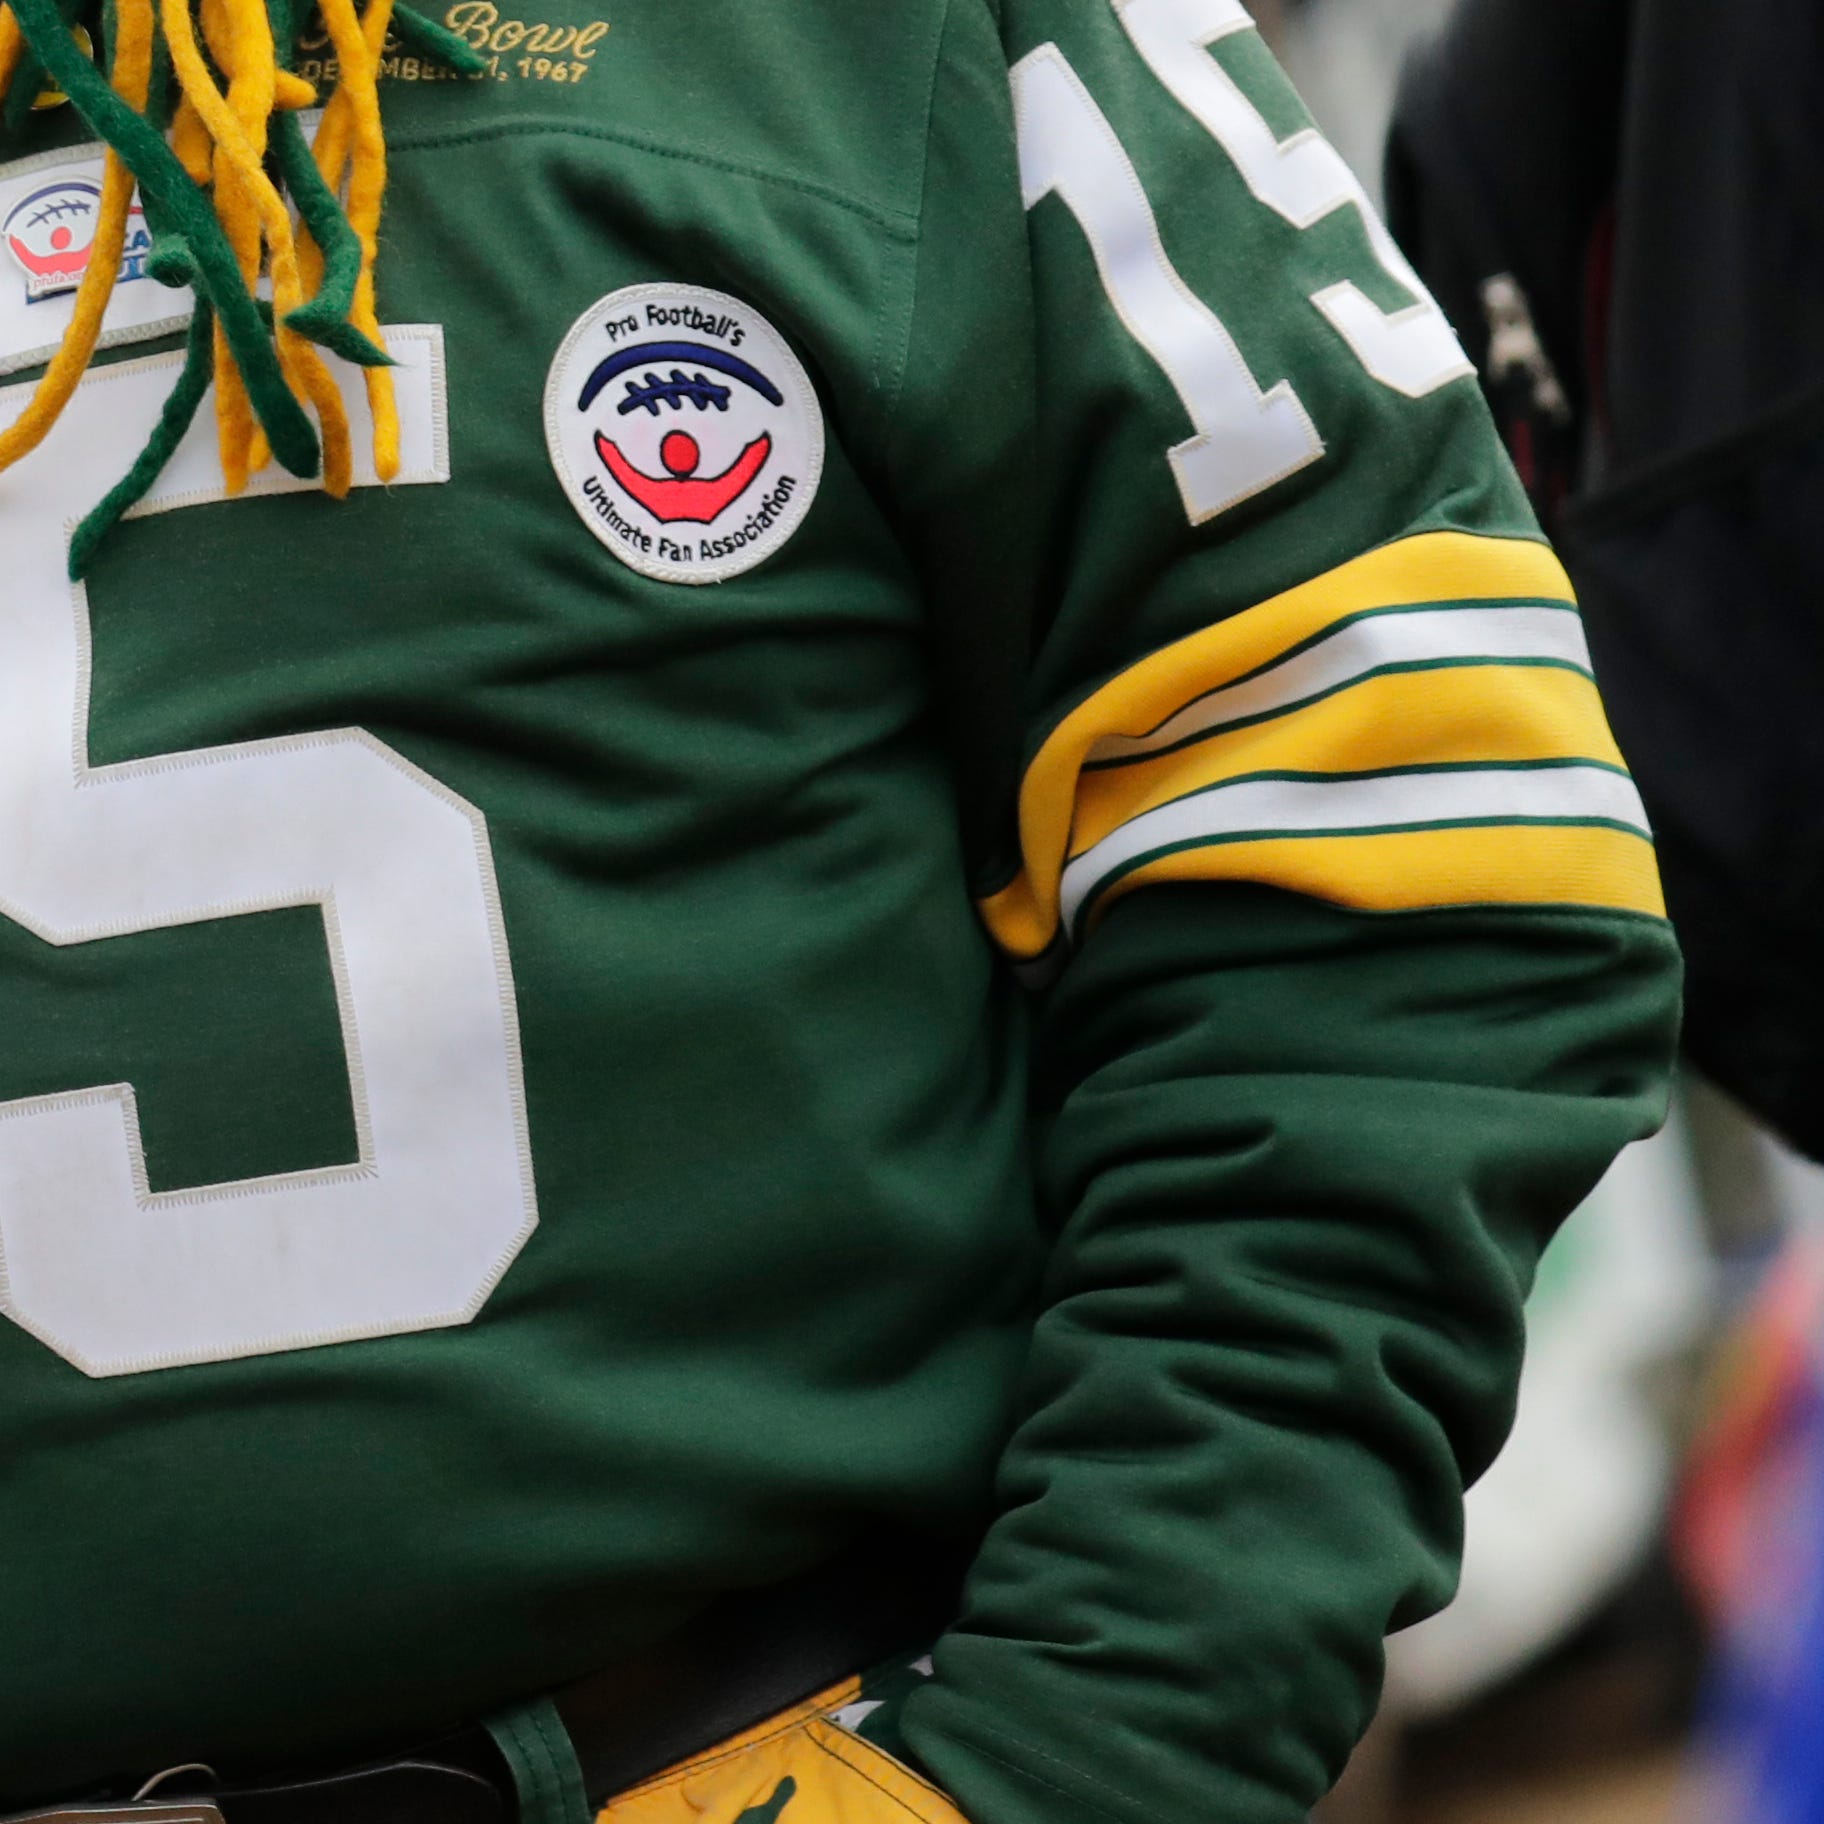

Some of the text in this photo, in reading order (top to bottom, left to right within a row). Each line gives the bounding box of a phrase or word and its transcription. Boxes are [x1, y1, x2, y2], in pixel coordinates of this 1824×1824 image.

[445, 1, 610, 59] Bowl
[517, 56, 588, 83] 1967
[605, 303, 747, 348] Pro Football's
[583, 474, 798, 562] Ultimate Fan Association
